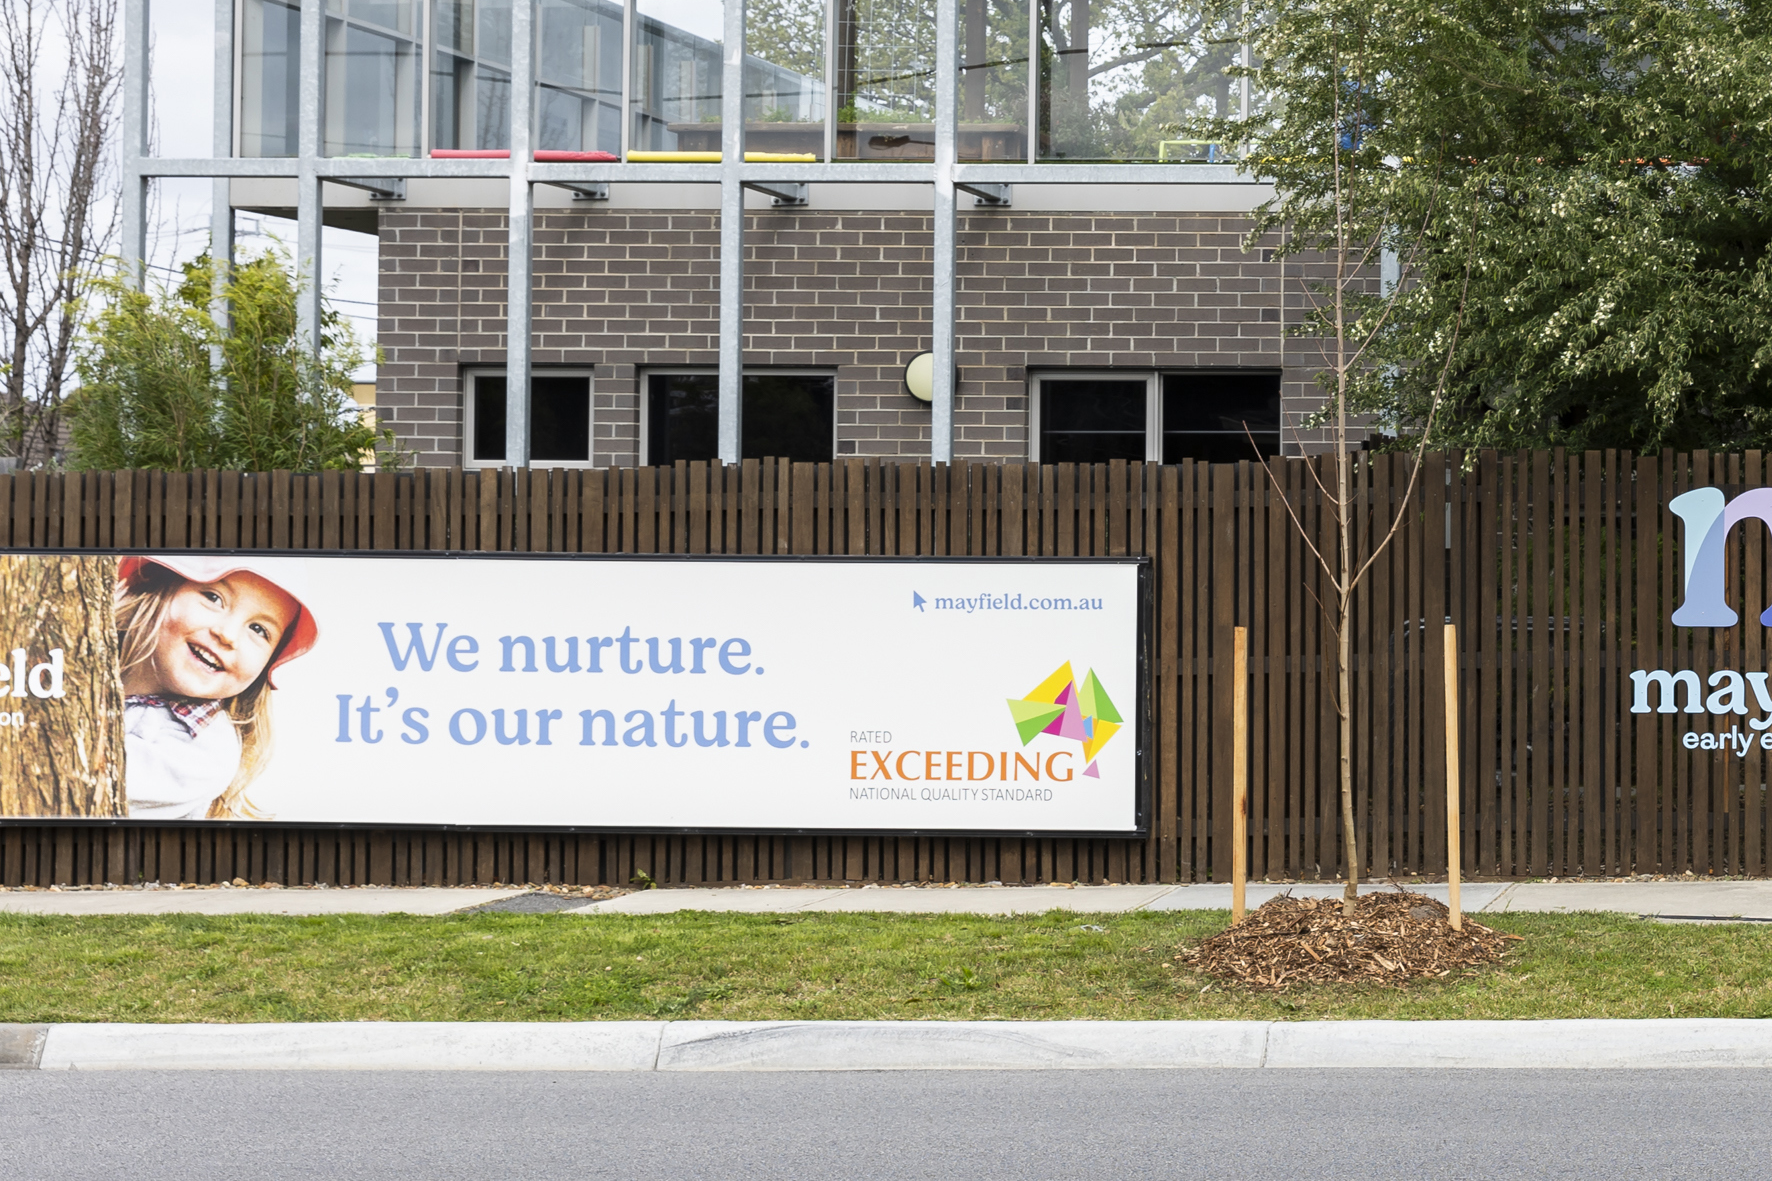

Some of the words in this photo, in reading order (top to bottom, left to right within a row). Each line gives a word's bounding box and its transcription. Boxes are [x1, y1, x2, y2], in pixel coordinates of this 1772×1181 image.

[935, 592, 1103, 615] mayfield.com.au
[377, 621, 480, 673] We
[498, 624, 766, 676] nurture.
[335, 686, 430, 745] It’s
[448, 706, 563, 746] our
[578, 699, 810, 749] nature.
[850, 730, 892, 744] RATED
[1682, 724, 1755, 758] early
[850, 750, 1074, 782] EXCEEDING
[849, 787, 917, 801] NATIONAL
[920, 787, 979, 802] QUALITY
[981, 788, 1053, 802] STANDARD
